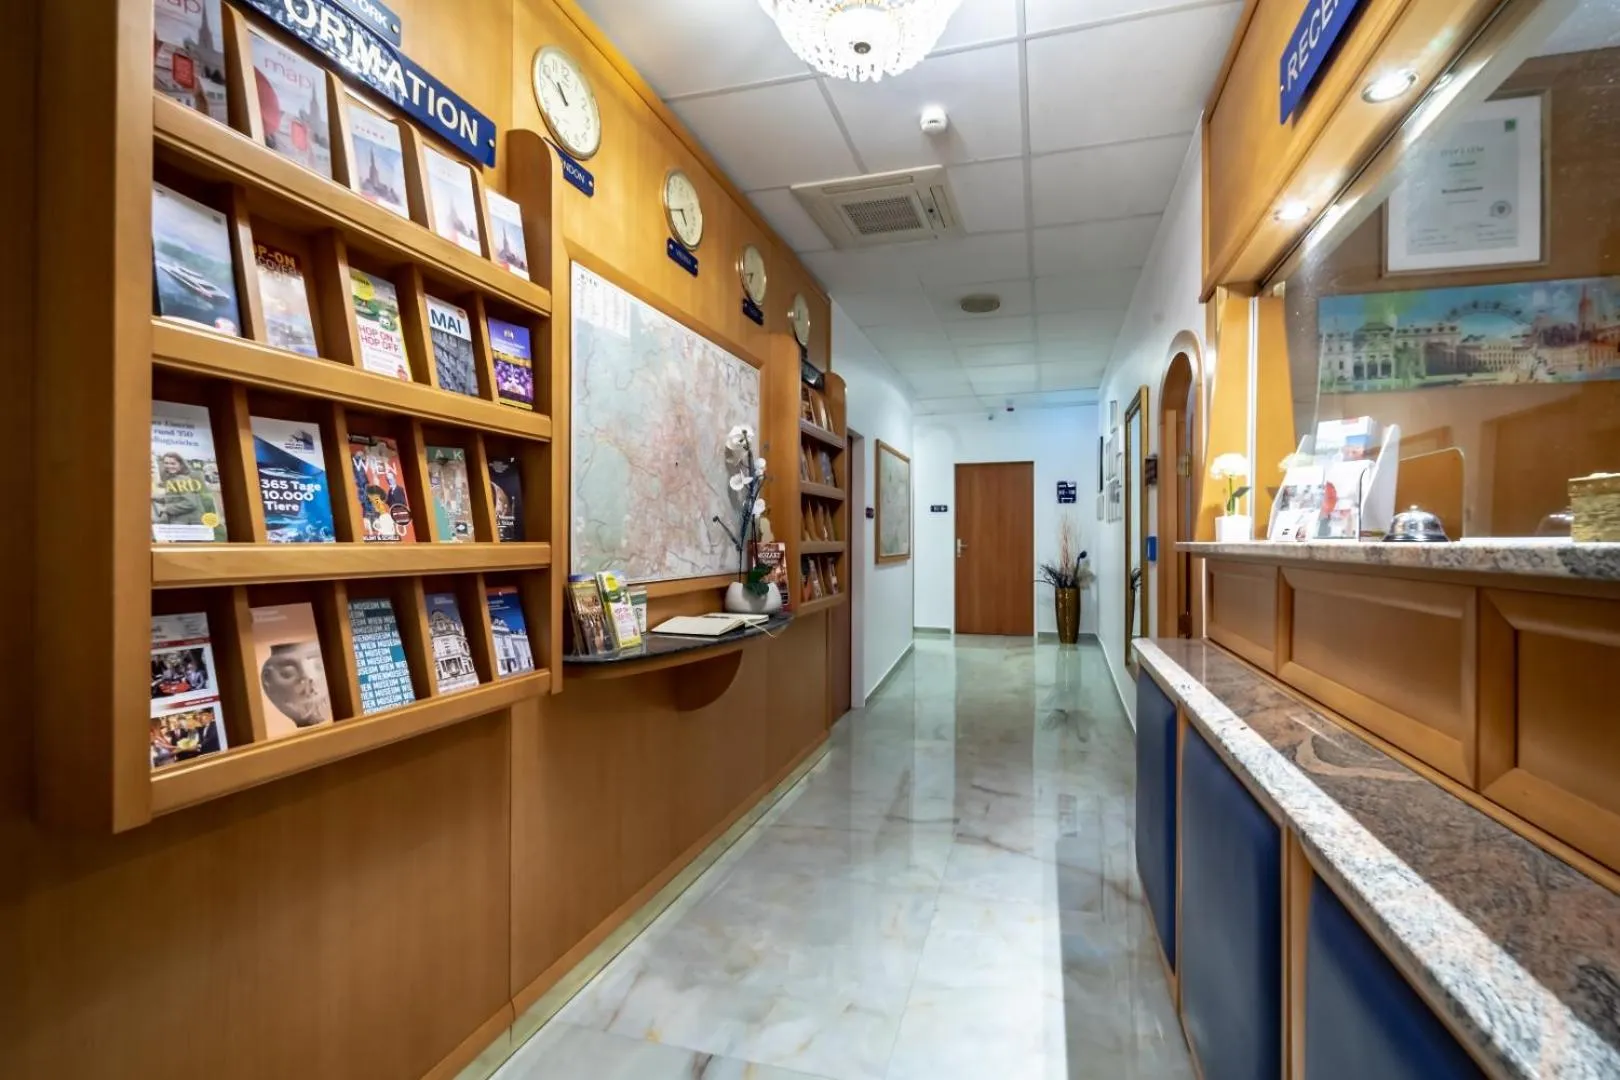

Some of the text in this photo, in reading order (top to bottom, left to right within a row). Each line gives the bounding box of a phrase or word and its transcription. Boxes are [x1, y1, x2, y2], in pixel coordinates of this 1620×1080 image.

[353, 0, 388, 29] ORK
[1287, 0, 1338, 91] RECE
[431, 309, 461, 334] MAI
[261, 479, 322, 493] 365 Tage
[262, 490, 314, 502] 10.000
[264, 500, 300, 512] Tiere
